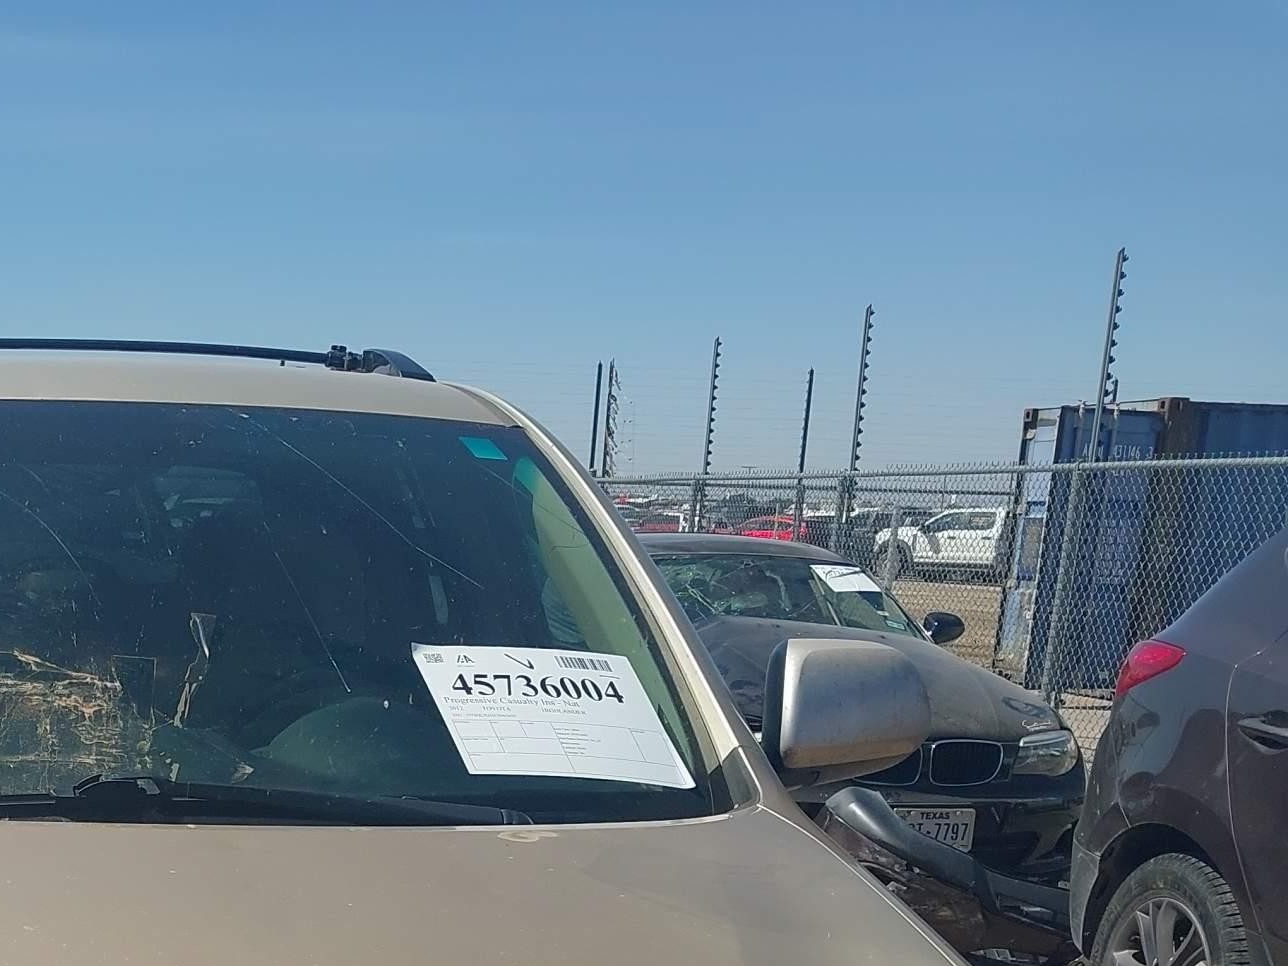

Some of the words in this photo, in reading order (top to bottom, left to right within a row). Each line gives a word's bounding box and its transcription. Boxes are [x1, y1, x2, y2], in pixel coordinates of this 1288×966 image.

[452, 673, 624, 704] 45736004
[443, 696, 497, 706] Progressive
[499, 697, 538, 707] Casualty
[920, 812, 951, 820] TEXAS
